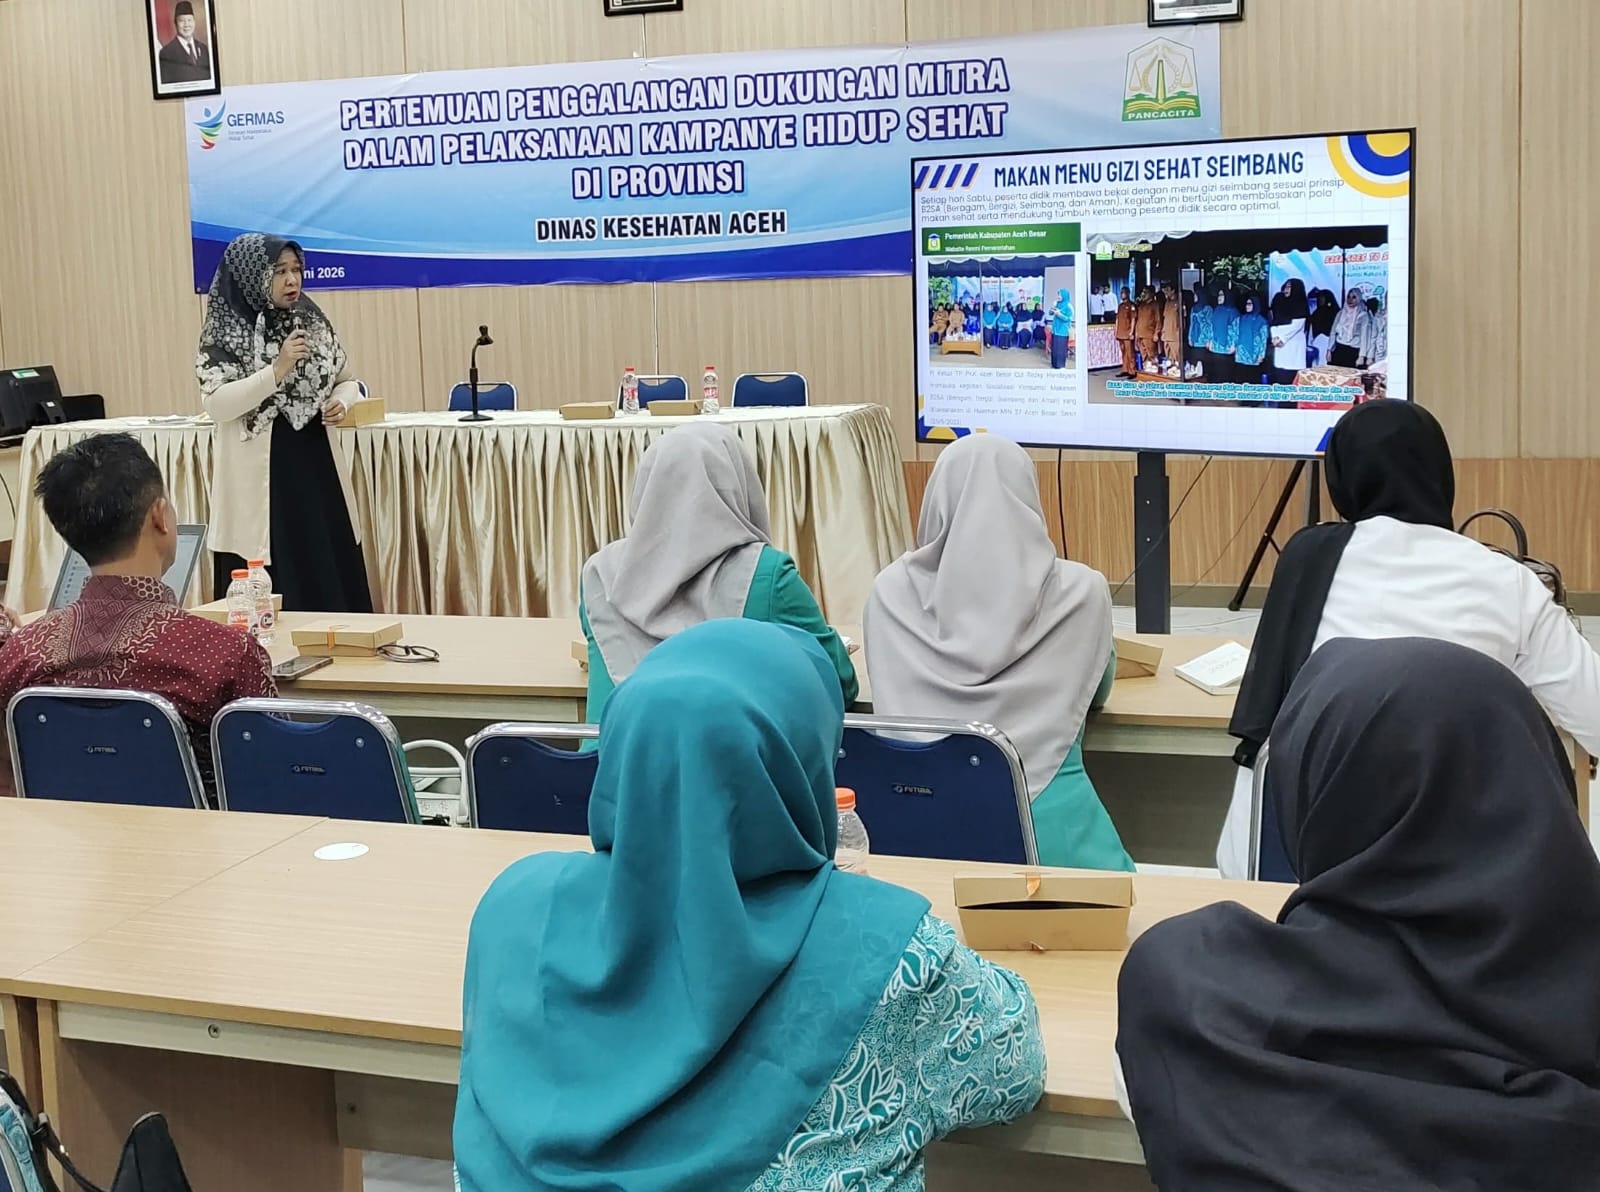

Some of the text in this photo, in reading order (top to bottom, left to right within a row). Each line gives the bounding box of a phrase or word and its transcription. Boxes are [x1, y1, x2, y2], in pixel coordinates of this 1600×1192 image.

[341, 58, 1009, 130] PERTEMUAN PENGGALANGAN DUKUNGAN MITRA
[227, 111, 285, 127] GERMAS
[1128, 109, 1195, 120] PANCACITA
[344, 103, 1007, 169] DALAM PELAKSANAAN KAMPANYE HIDUP SEHAT
[572, 162, 744, 200] DI PROVINSI
[994, 151, 1304, 187] MAKAN MENU GIZI SEHAT SEIMBANG
[921, 196, 946, 206] Setiap
[949, 194, 964, 203] hari
[995, 192, 1028, 201] peserta
[1030, 190, 1050, 199] didik
[1053, 189, 1102, 198] membawa
[1104, 187, 1129, 196] bekal
[1131, 187, 1168, 196] dengan
[1170, 185, 1199, 193] menu
[1201, 183, 1217, 195] gizi
[1219, 181, 1271, 192] seimbang
[1273, 180, 1306, 189] sesuai
[1309, 177, 1345, 189] prinsip
[921, 204, 941, 214] B2SA
[1069, 199, 1087, 207] dan
[1124, 195, 1166, 206] Kegiatan
[1169, 194, 1180, 203] ini
[1182, 193, 1229, 204] bertujuan
[1232, 190, 1306, 200] membiasakan
[1309, 188, 1332, 200] pola
[535, 210, 786, 242] DINAS KESEHATAN ACEH
[921, 213, 950, 222] makan
[952, 213, 975, 221] sehat
[978, 212, 998, 220] serta
[1001, 210, 1052, 220] mendukung
[1055, 208, 1090, 217] tumbuh
[1093, 206, 1137, 217] kembang
[1140, 205, 1175, 216] peserta
[1178, 203, 1200, 213] didik
[1203, 203, 1237, 212] secara
[945, 232, 978, 240] Pemerintah
[979, 231, 1011, 239] Kabupaten
[1012, 230, 1028, 238] Aceh
[304, 266, 346, 279] ni 2026
